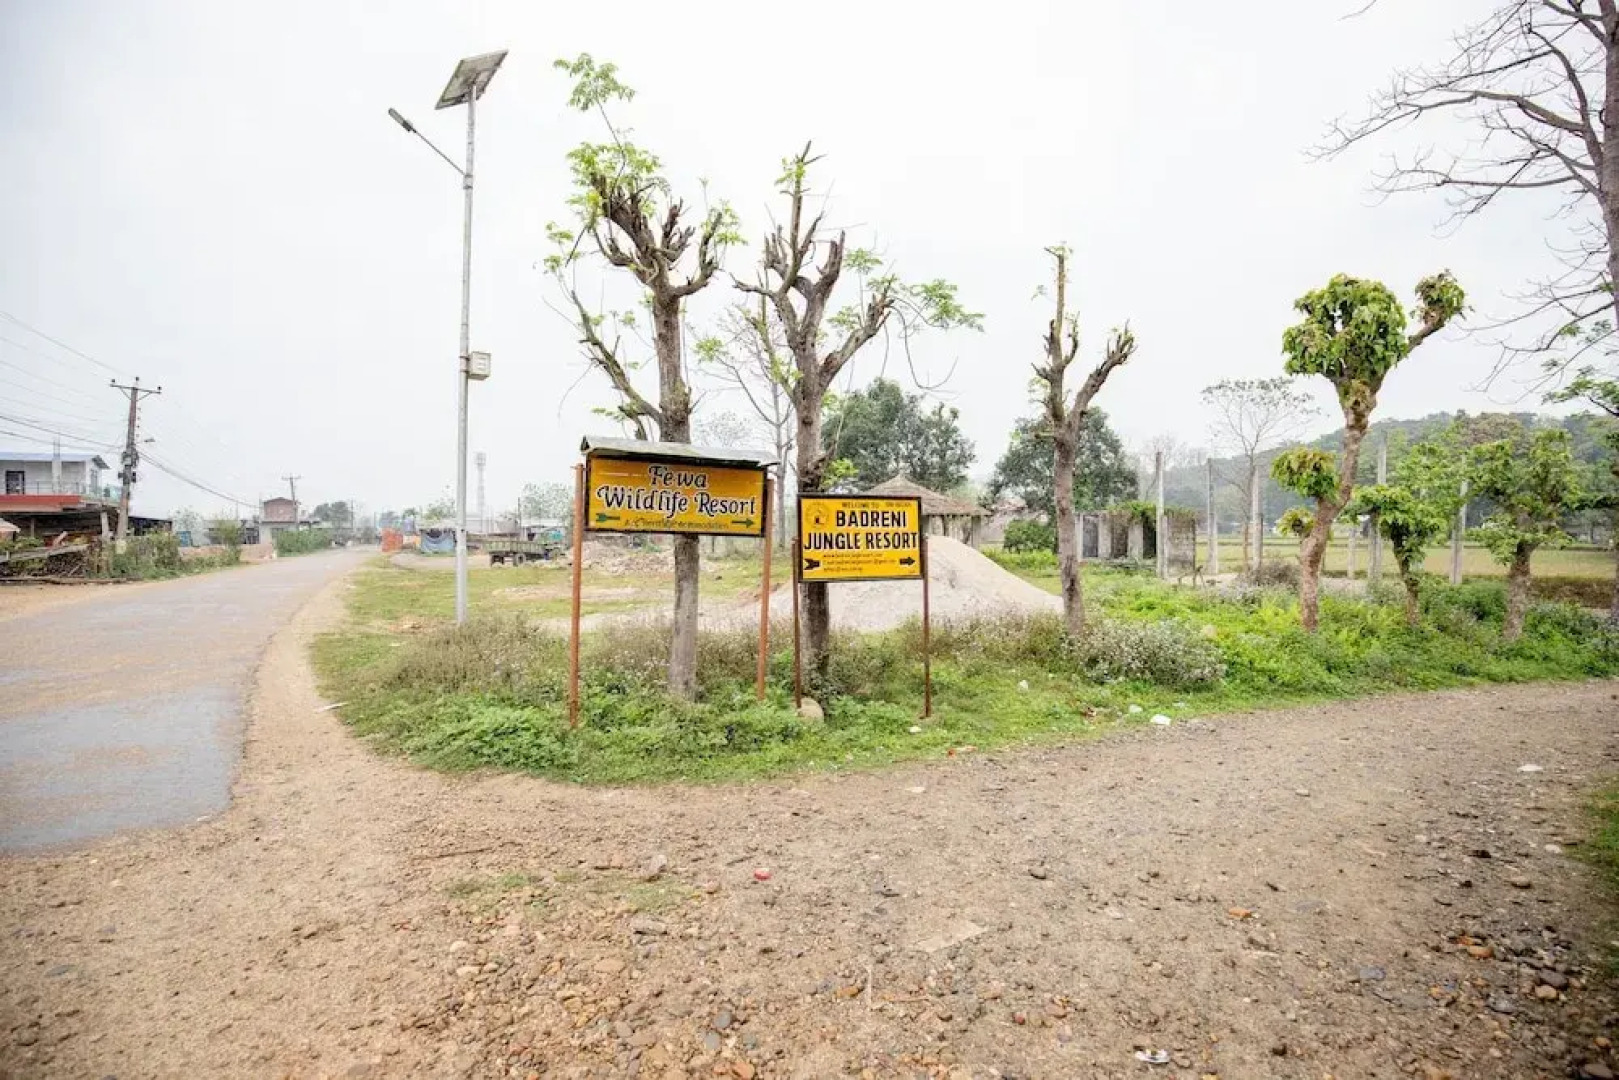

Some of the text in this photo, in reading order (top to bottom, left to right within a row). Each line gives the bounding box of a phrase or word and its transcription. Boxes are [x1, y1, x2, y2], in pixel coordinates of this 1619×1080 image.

[649, 466, 708, 488] Fewa
[597, 485, 756, 519] Wildlife Resort
[836, 510, 907, 527] BADRENI
[804, 532, 918, 550] JUNGLE RESORT
